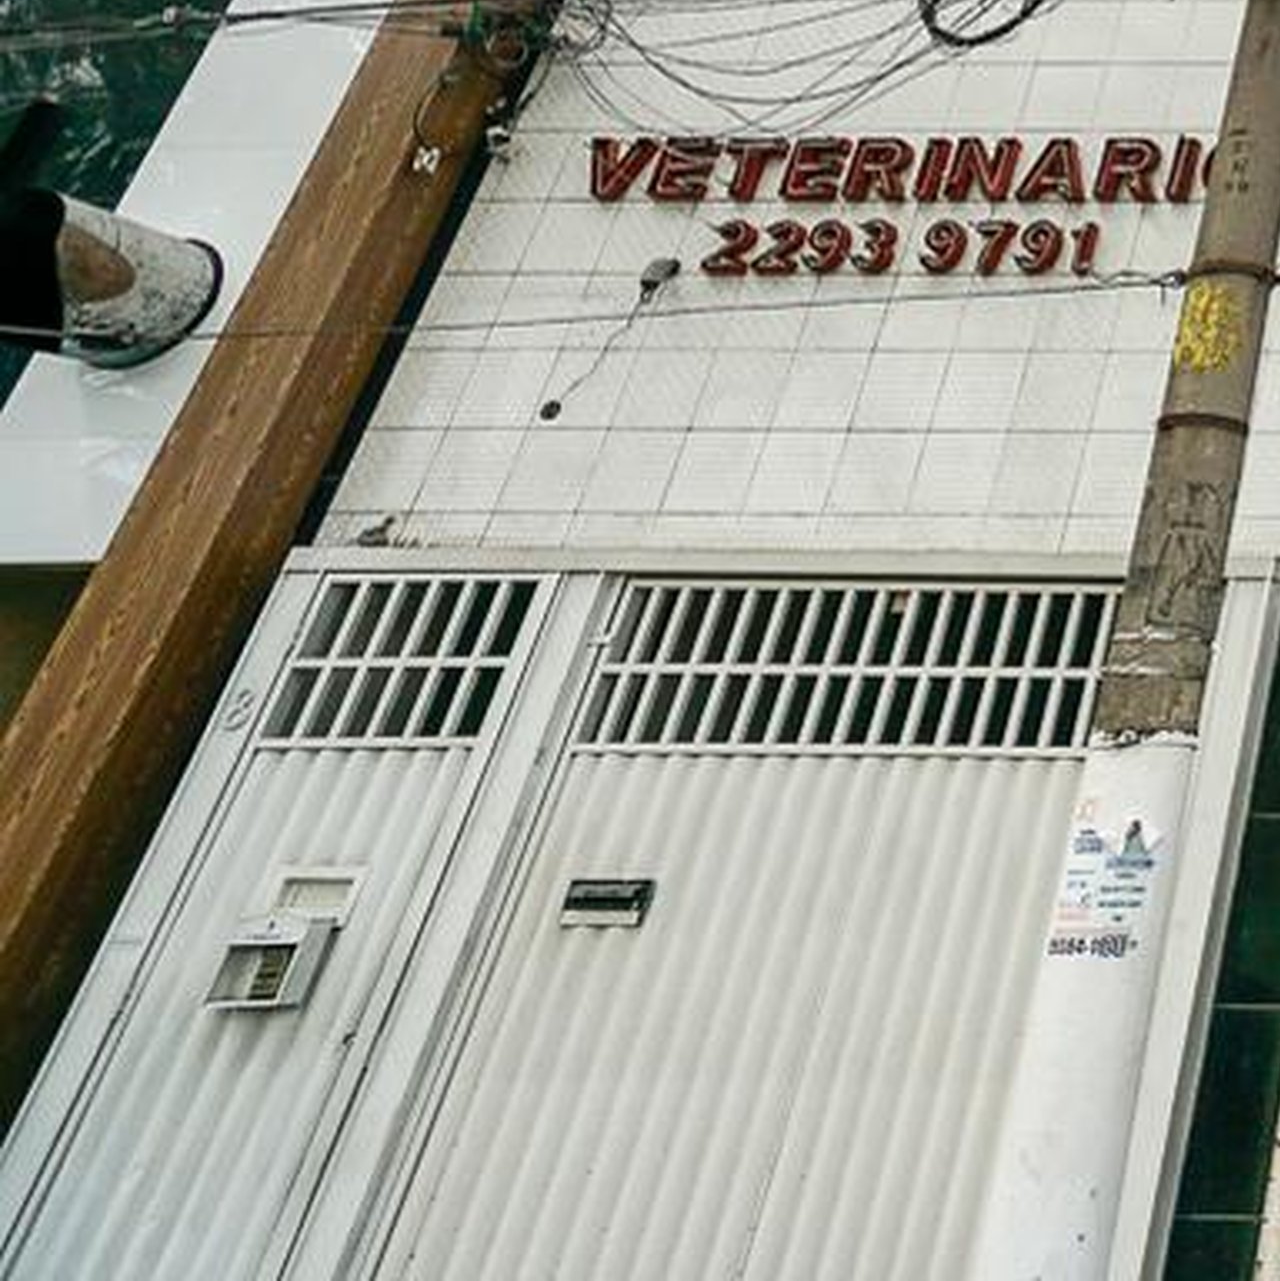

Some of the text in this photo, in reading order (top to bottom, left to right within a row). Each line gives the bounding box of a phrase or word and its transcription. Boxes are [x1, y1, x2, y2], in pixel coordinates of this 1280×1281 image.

[588, 134, 1216, 204] VETERINARI
[700, 218, 1101, 276] 2293 9791
